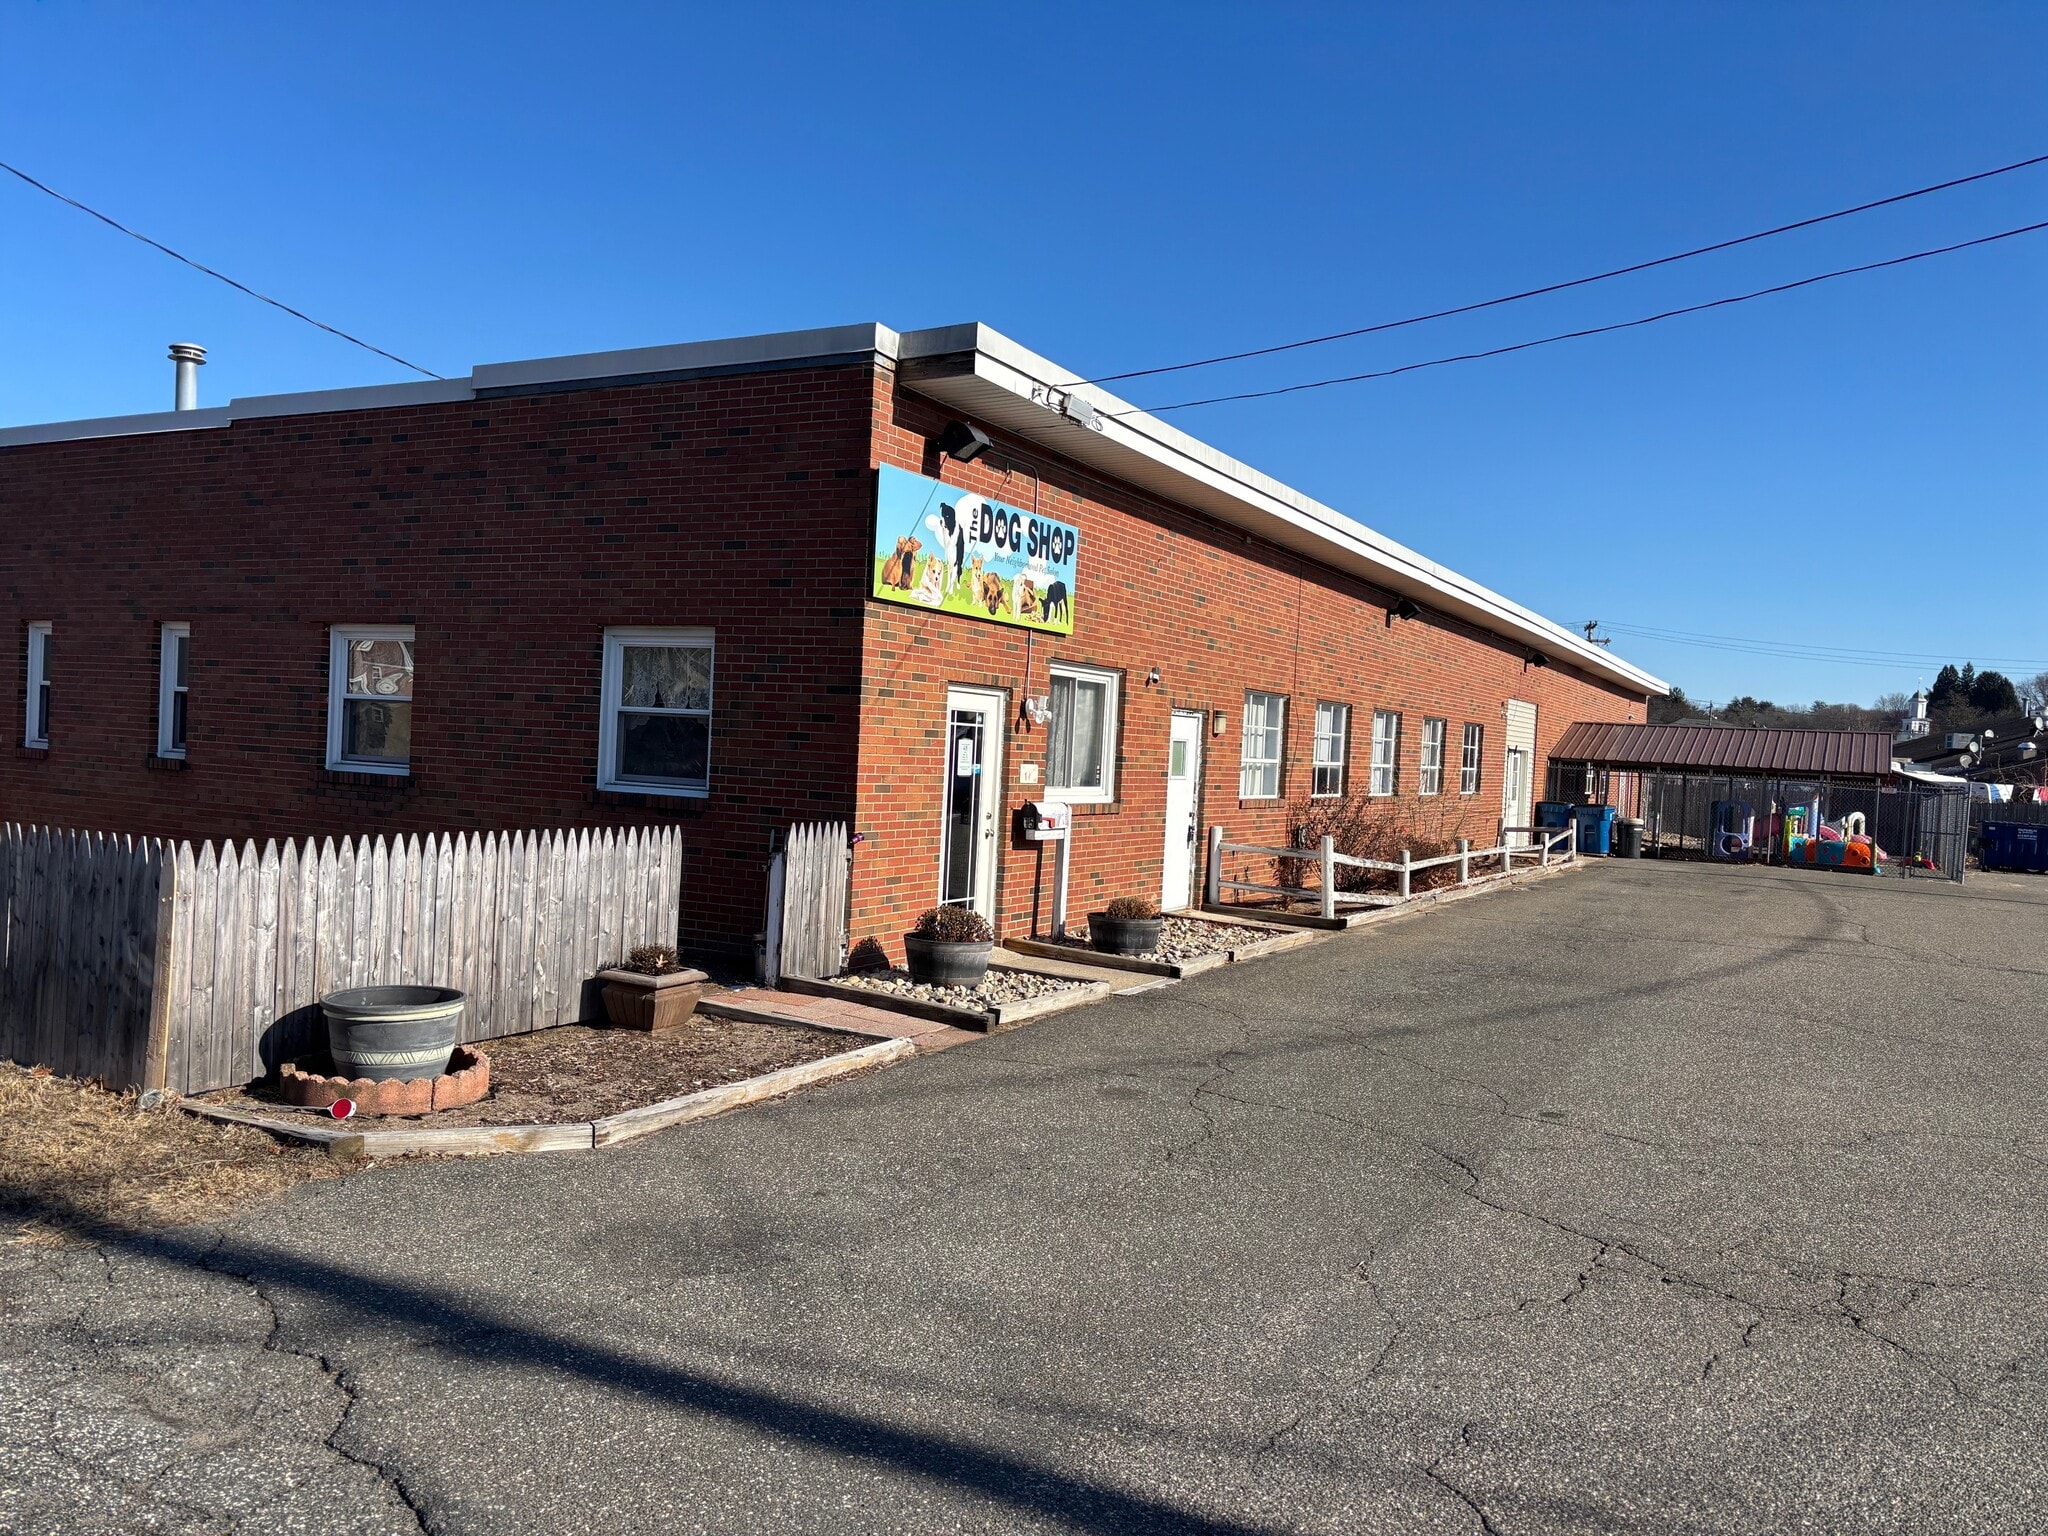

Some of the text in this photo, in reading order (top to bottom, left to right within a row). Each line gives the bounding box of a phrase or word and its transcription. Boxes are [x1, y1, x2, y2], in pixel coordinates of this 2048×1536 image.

[969, 508, 979, 544] The
[979, 502, 1075, 566] DOG SHOP
